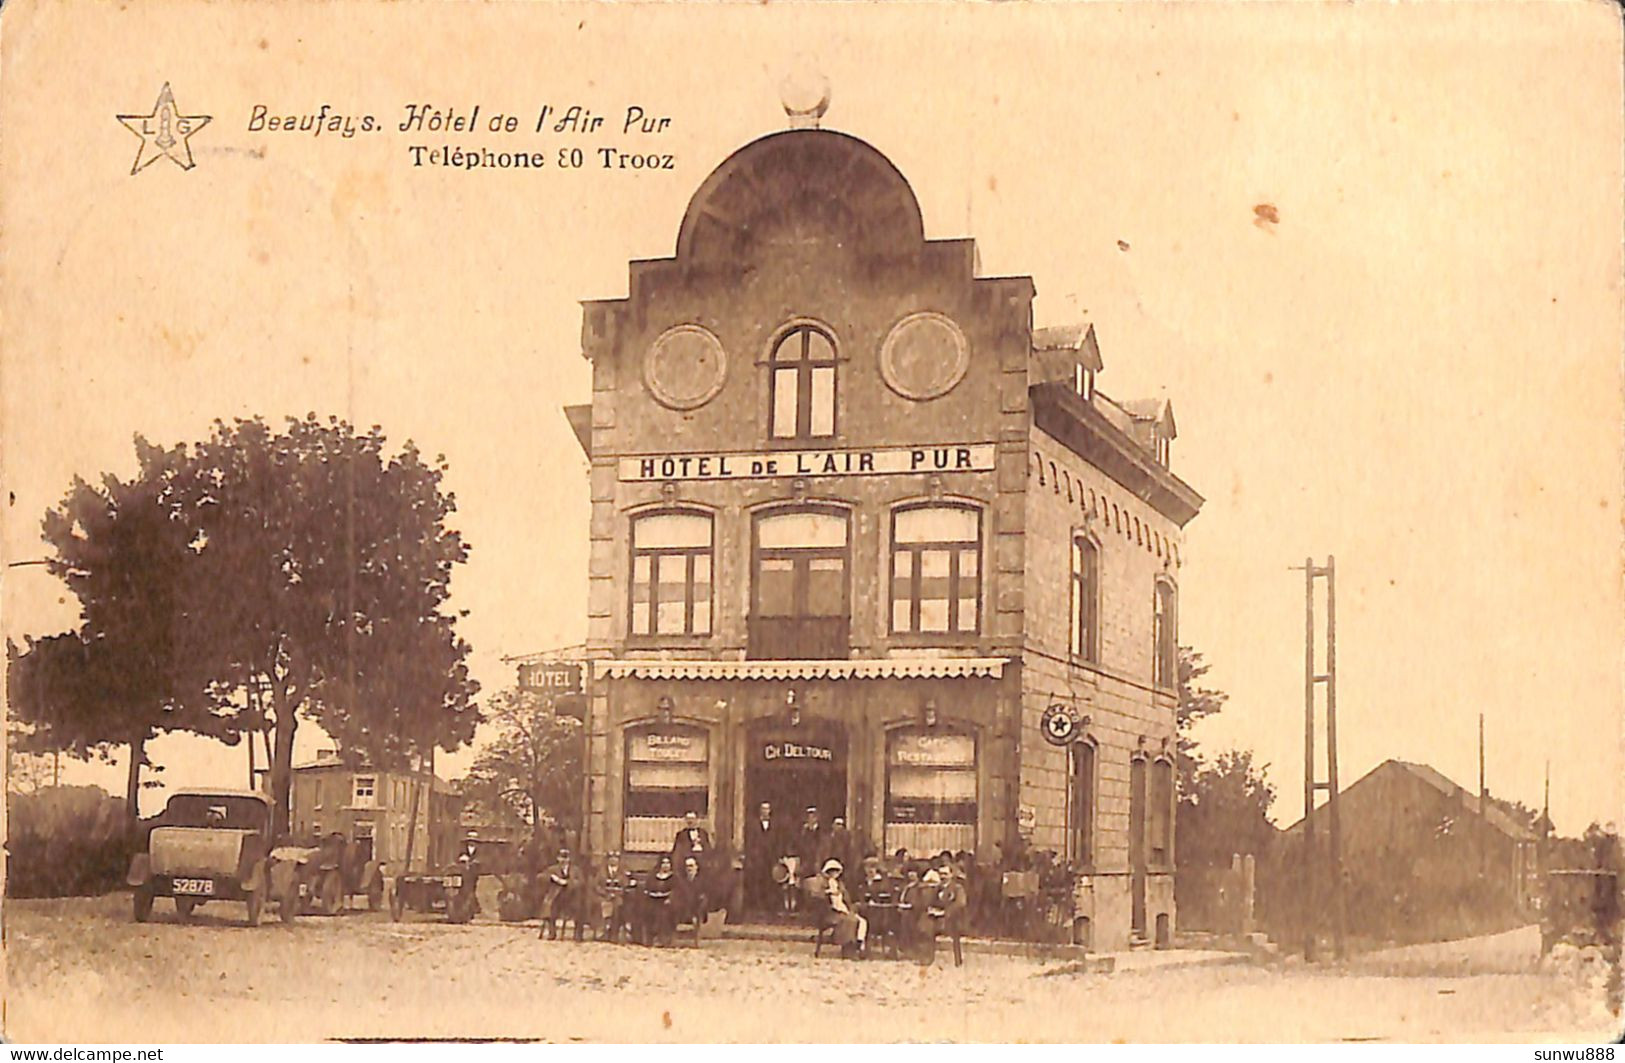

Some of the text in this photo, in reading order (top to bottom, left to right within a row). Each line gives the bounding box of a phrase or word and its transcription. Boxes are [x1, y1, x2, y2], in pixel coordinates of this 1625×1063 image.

[751, 460, 778, 475] DE
[796, 452, 875, 473] L'AIR
[911, 449, 972, 470] PUR
[172, 878, 214, 893] 52878
